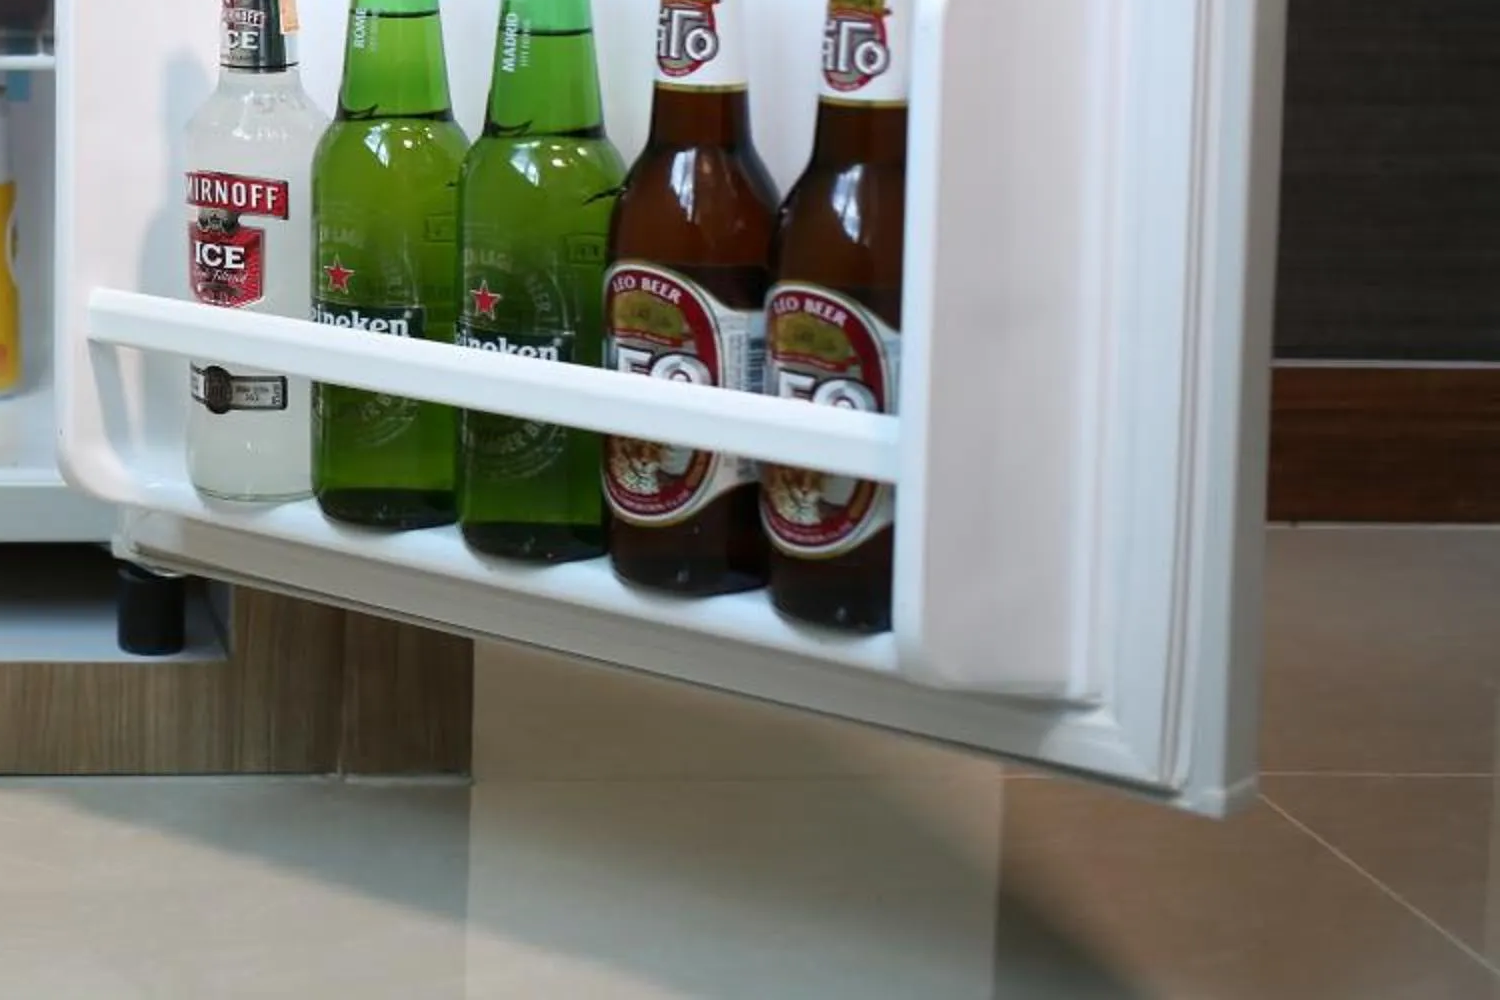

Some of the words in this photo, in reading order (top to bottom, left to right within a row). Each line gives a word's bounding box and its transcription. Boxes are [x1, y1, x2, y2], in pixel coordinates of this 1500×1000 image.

[227, 31, 258, 49] CE
[502, 12, 520, 73] MADRID
[187, 176, 279, 210] IRNOFF
[195, 241, 245, 269] ICE
[641, 277, 682, 304] BEER
[311, 304, 410, 338] ineken
